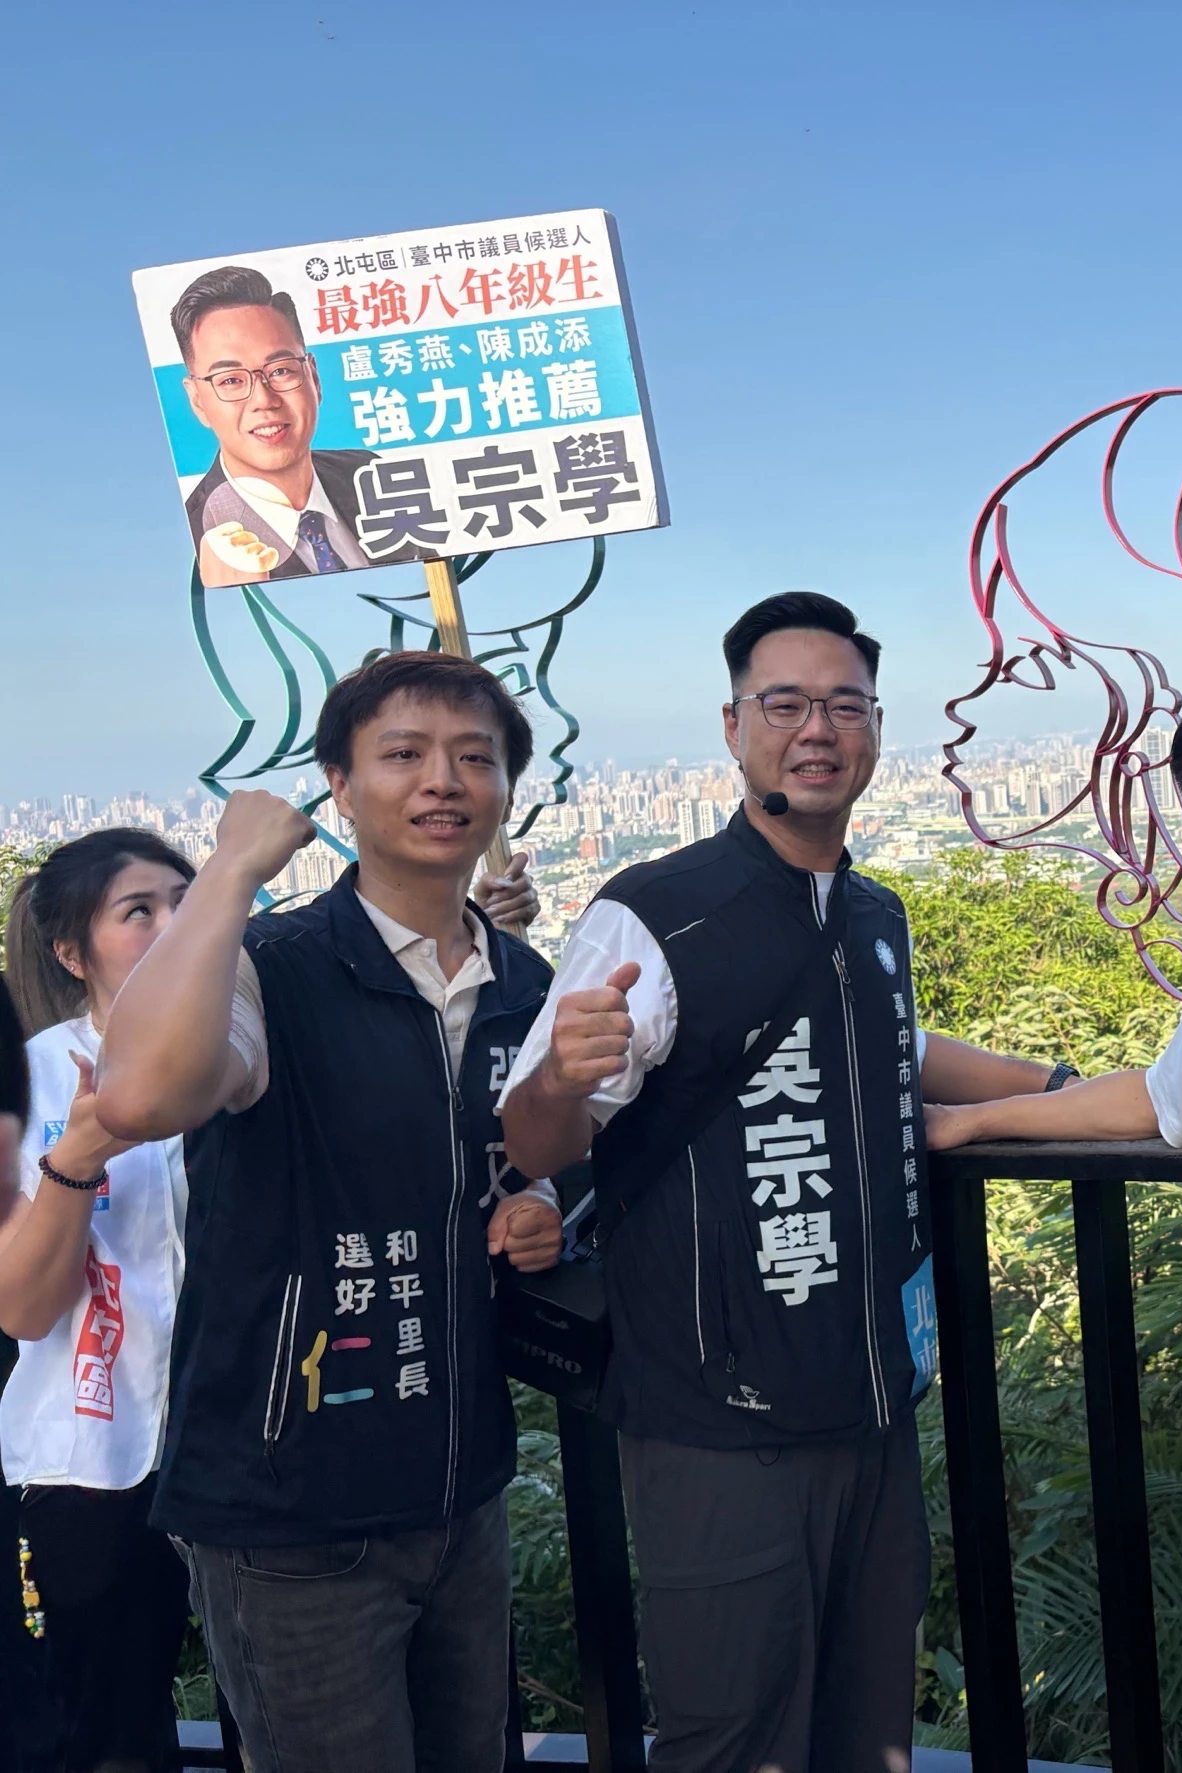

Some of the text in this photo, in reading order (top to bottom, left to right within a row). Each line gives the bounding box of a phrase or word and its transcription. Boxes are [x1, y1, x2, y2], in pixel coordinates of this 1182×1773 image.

[313, 254, 604, 336] 最強八年級生
[333, 224, 592, 278] 北屯區 臺中市議員候選人
[341, 316, 591, 383] 盧秀燕、陳成添
[349, 359, 602, 447] 強力推薦
[358, 430, 641, 554] 吳宗學
[737, 1016, 839, 1306] 吳宗學
[892, 993, 921, 1252] 臺中市議員候選人
[385, 1230, 430, 1400] 和平里長
